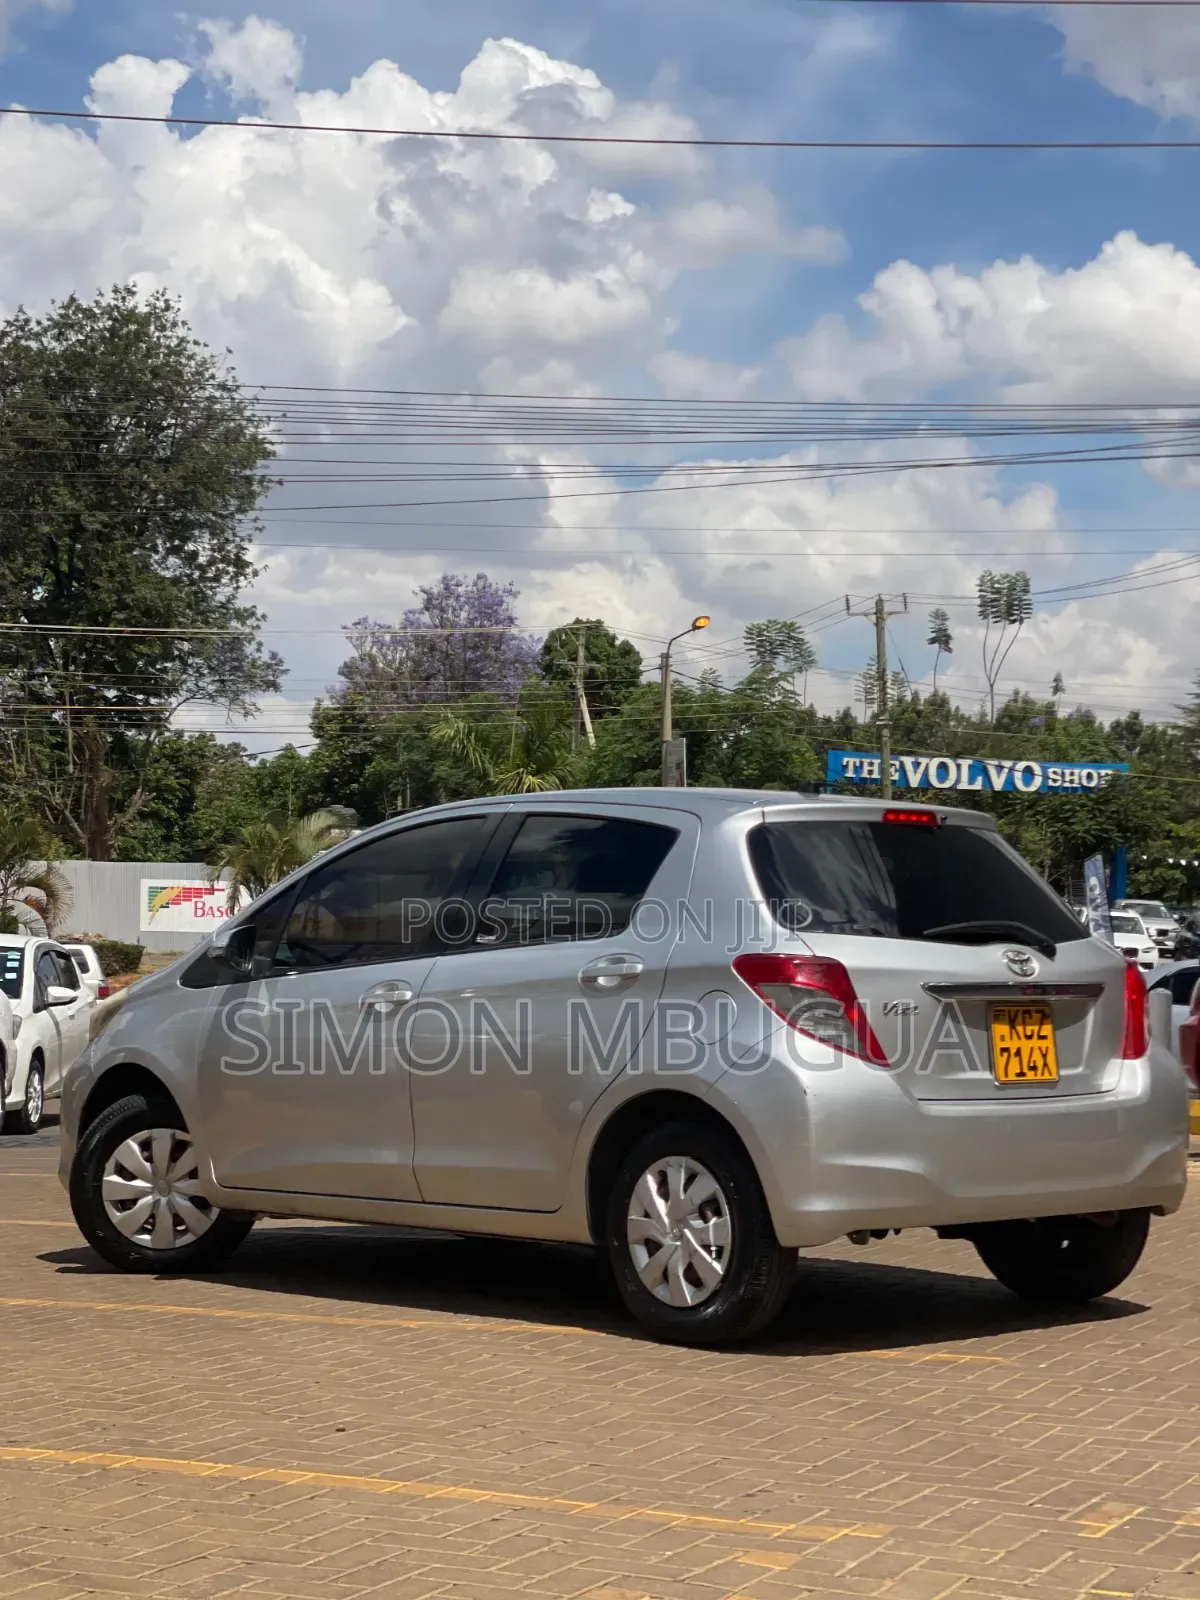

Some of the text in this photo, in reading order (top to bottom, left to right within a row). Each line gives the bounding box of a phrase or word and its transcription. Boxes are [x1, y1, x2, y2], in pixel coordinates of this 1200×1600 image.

[842, 757, 900, 780] THE
[900, 756, 1043, 792] VOLVO
[1007, 1008, 1049, 1040] KCZ
[999, 1046, 1053, 1078] 714X
